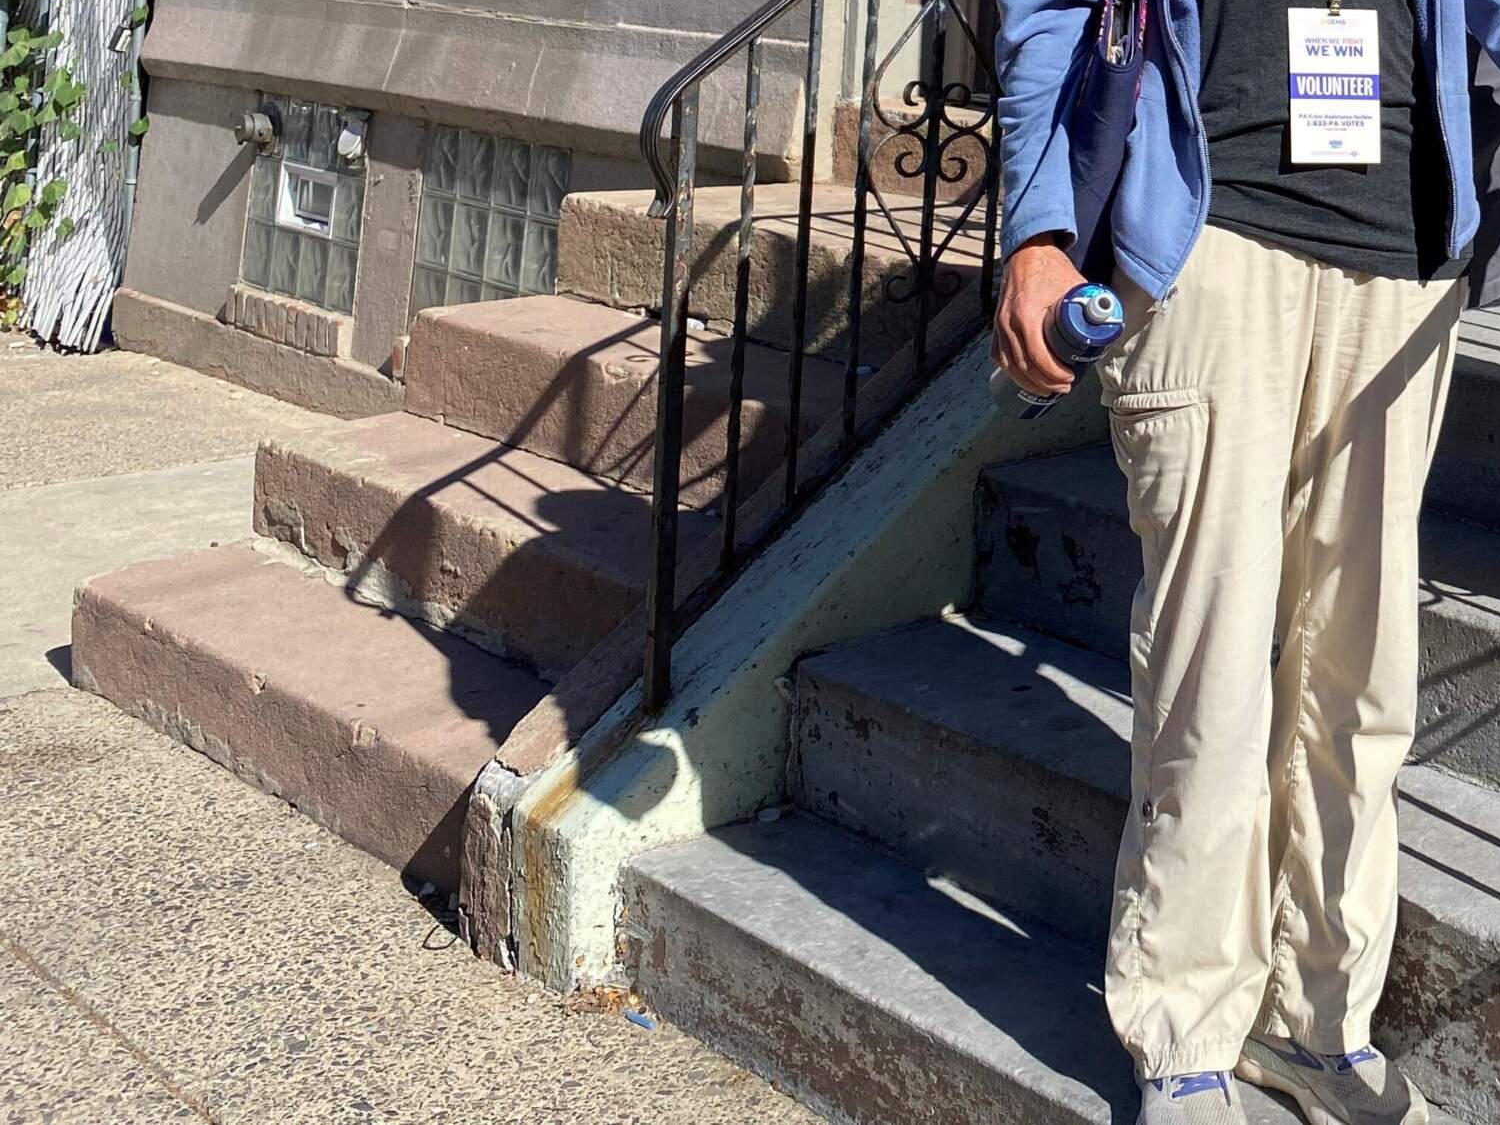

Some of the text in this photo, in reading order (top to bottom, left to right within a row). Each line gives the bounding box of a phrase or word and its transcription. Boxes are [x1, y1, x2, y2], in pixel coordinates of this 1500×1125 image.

[1328, 37, 1341, 45] WE
[1305, 44, 1363, 57] WE WIN
[1297, 76, 1373, 96] VOLUNTEER
